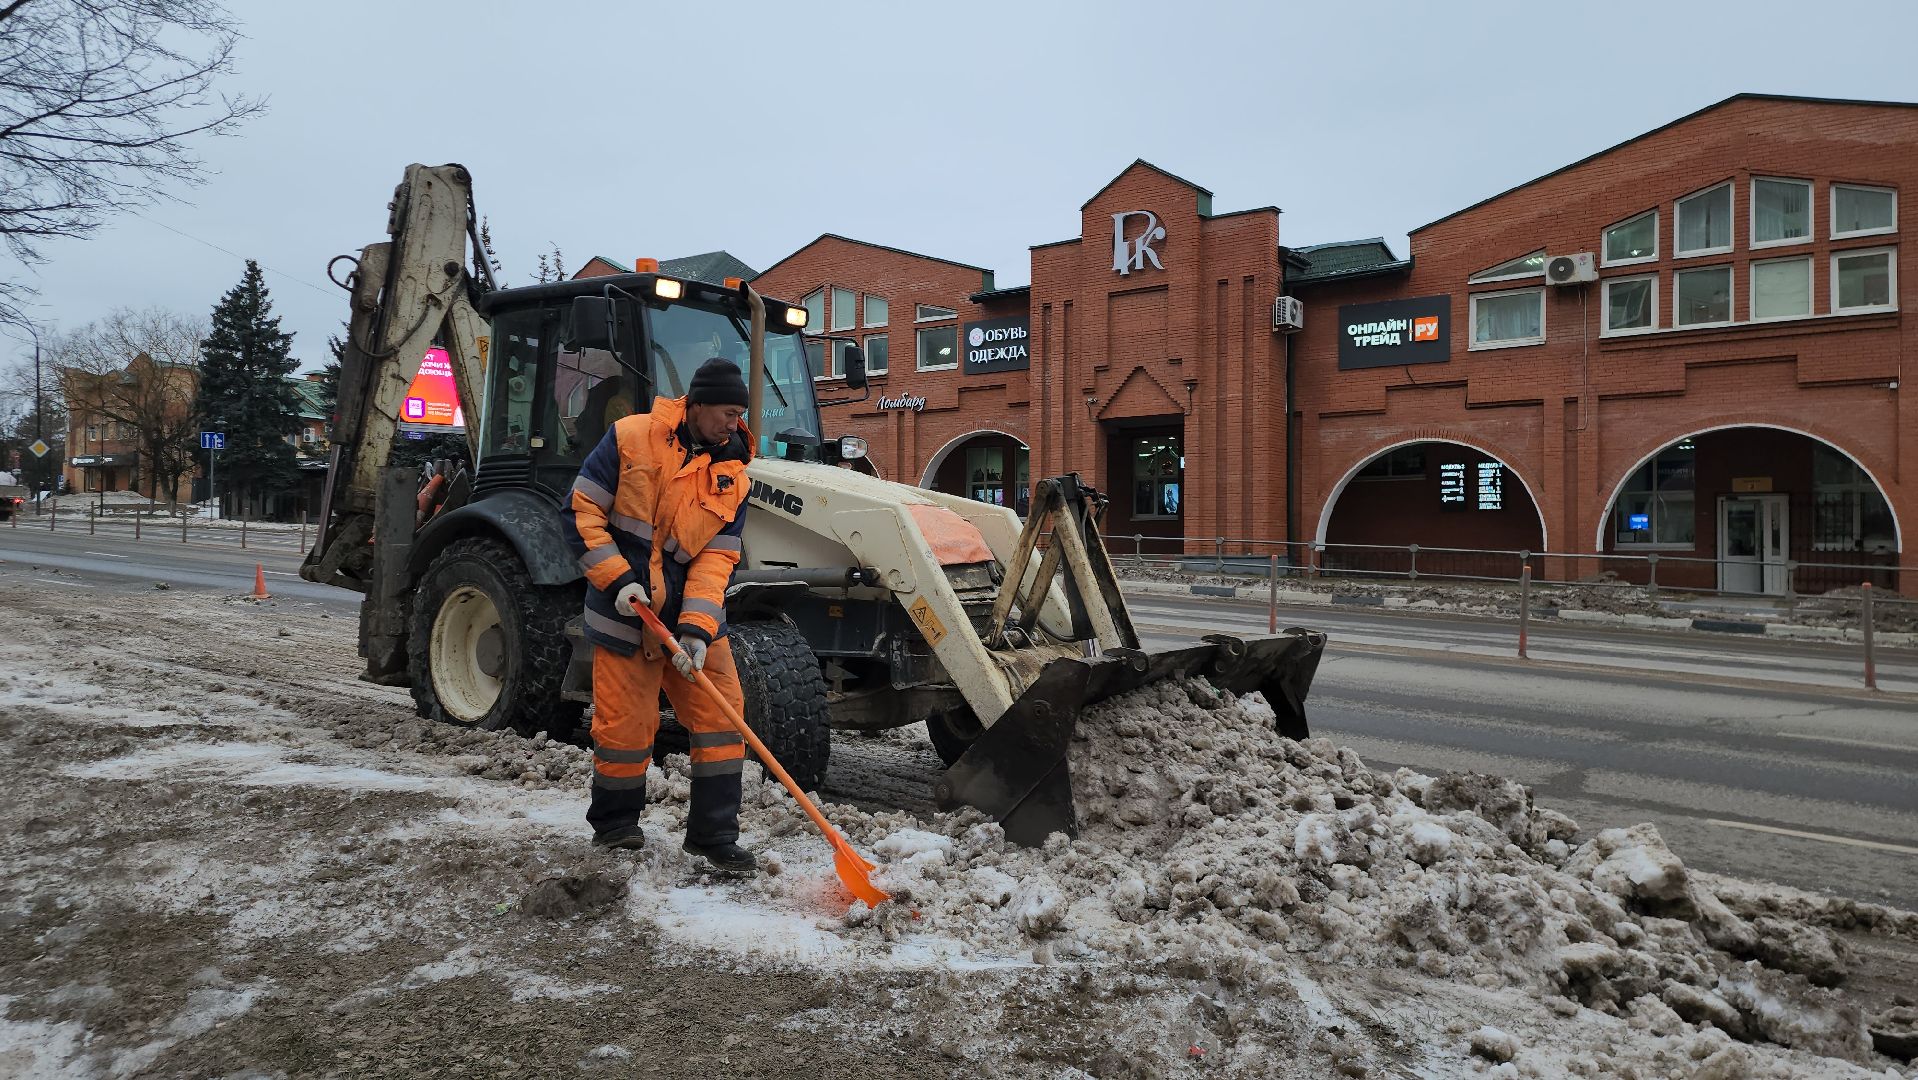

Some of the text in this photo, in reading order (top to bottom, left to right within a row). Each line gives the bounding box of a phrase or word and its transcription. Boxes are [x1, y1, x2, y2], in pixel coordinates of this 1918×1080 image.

[985, 326, 1027, 342] ОБУВЬ
[1347, 318, 1407, 336] ОНЛАЙН
[1415, 322, 1438, 337] РУ
[1353, 331, 1401, 347] ТРЕЙД
[969, 345, 1028, 364] ОДЕЖДА
[876, 392, 926, 411] Ломбард
